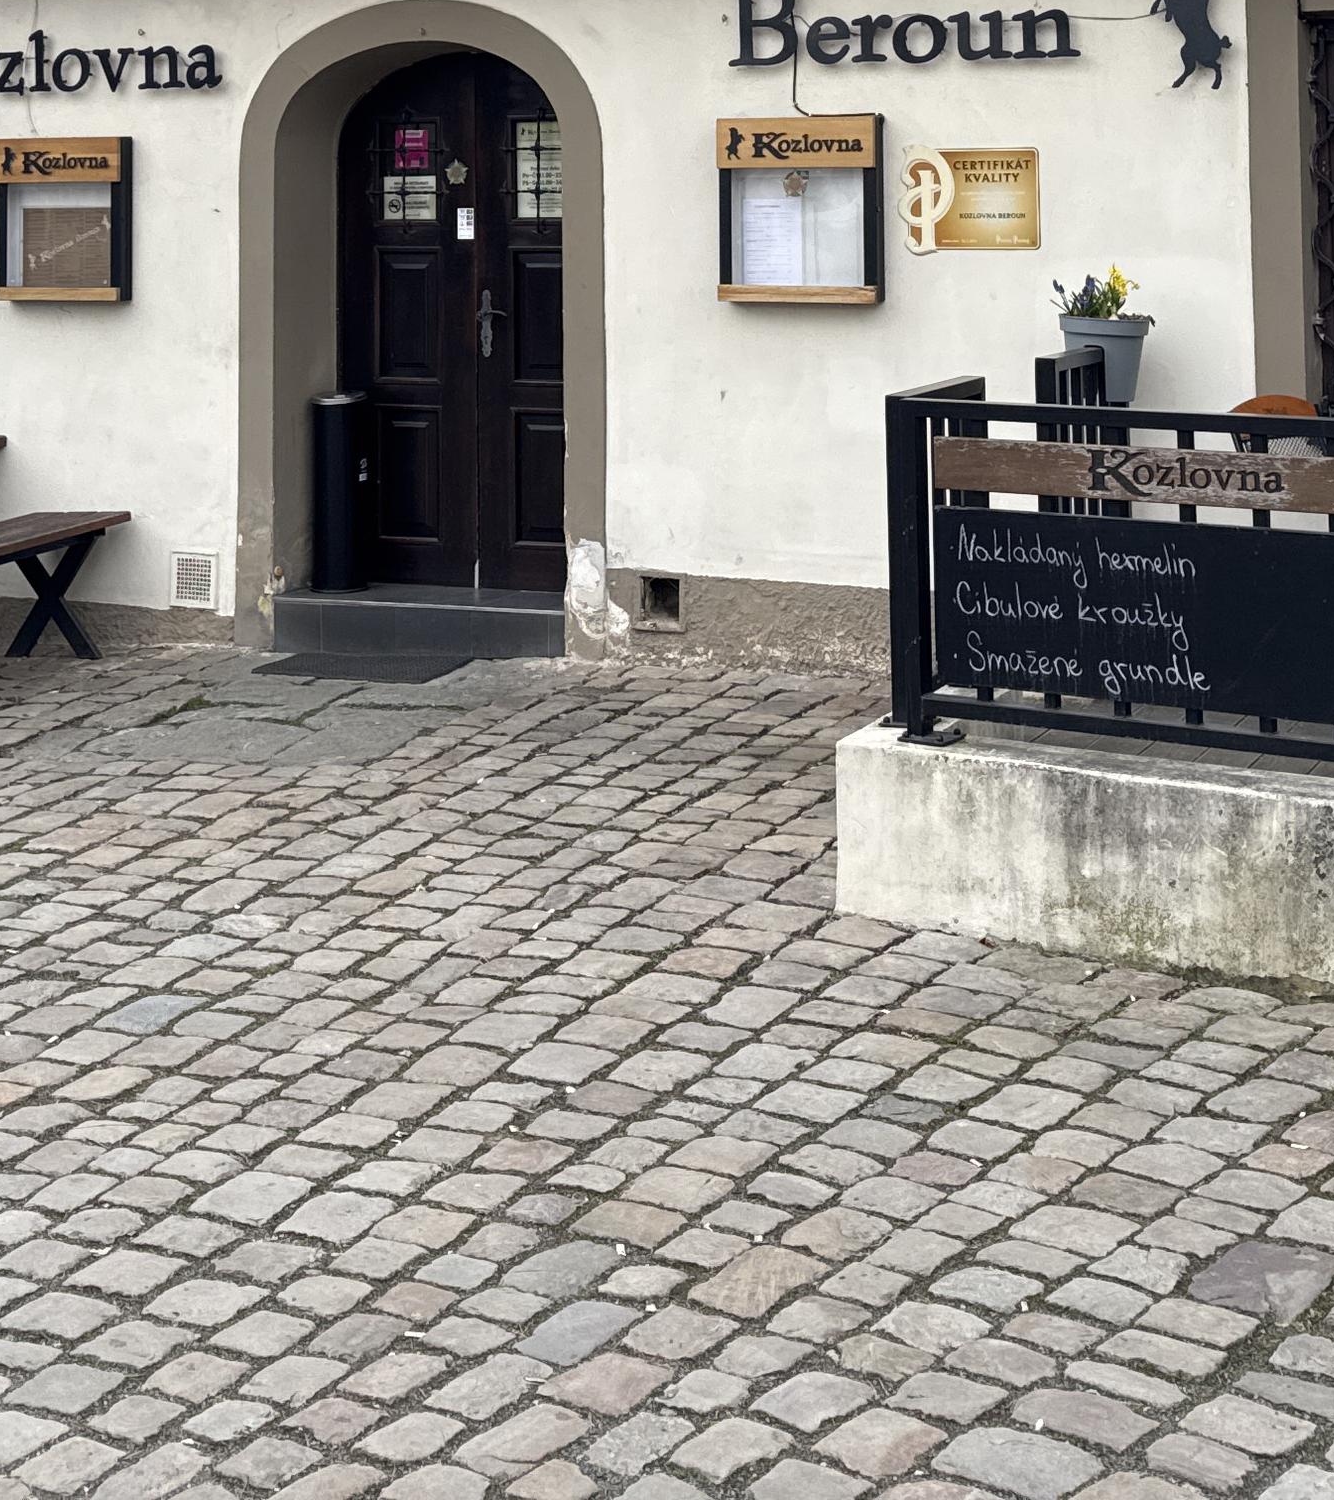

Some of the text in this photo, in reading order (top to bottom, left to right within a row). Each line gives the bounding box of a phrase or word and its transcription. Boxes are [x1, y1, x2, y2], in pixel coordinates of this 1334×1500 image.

[22, 151, 110, 175] Kozlovna
[752, 132, 864, 160] Kozlovna
[953, 158, 1031, 170] CERTIFIKÁT
[964, 172, 1020, 183] KVALITY
[1085, 448, 1285, 497] Kozlovna
[958, 523, 1088, 589] Nakládaný
[956, 581, 1190, 651] Cibulové kroužky
[967, 630, 1211, 695] Smažené grundle
